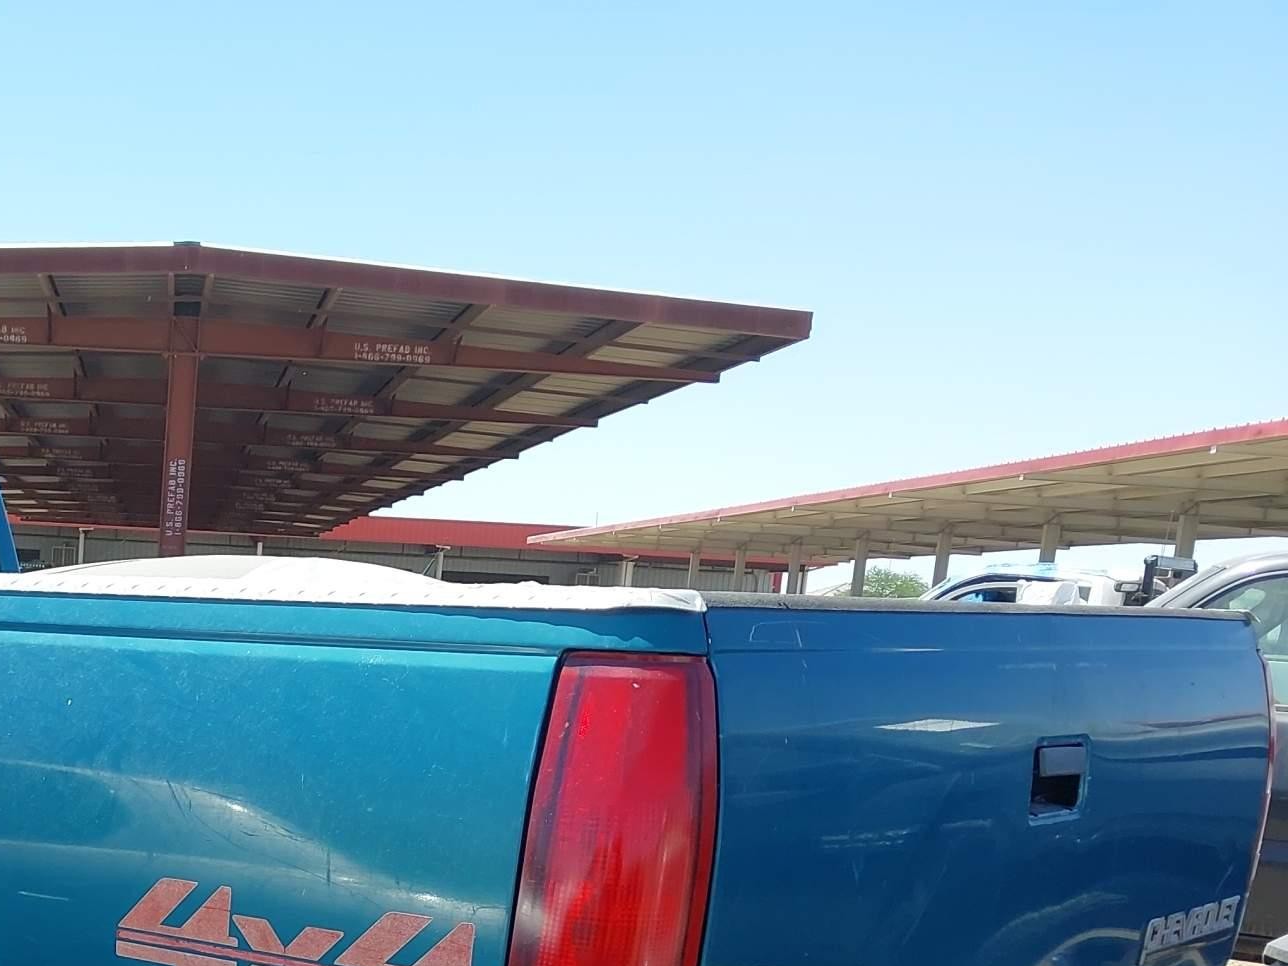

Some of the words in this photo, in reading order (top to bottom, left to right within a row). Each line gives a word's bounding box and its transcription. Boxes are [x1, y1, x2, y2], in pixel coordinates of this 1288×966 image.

[354, 342, 370, 352] U.S.
[375, 343, 410, 354] PREFAB
[166, 479, 176, 515] PREFAB
[165, 519, 174, 536] U.S.
[1144, 895, 1241, 952] CHEVROLET
